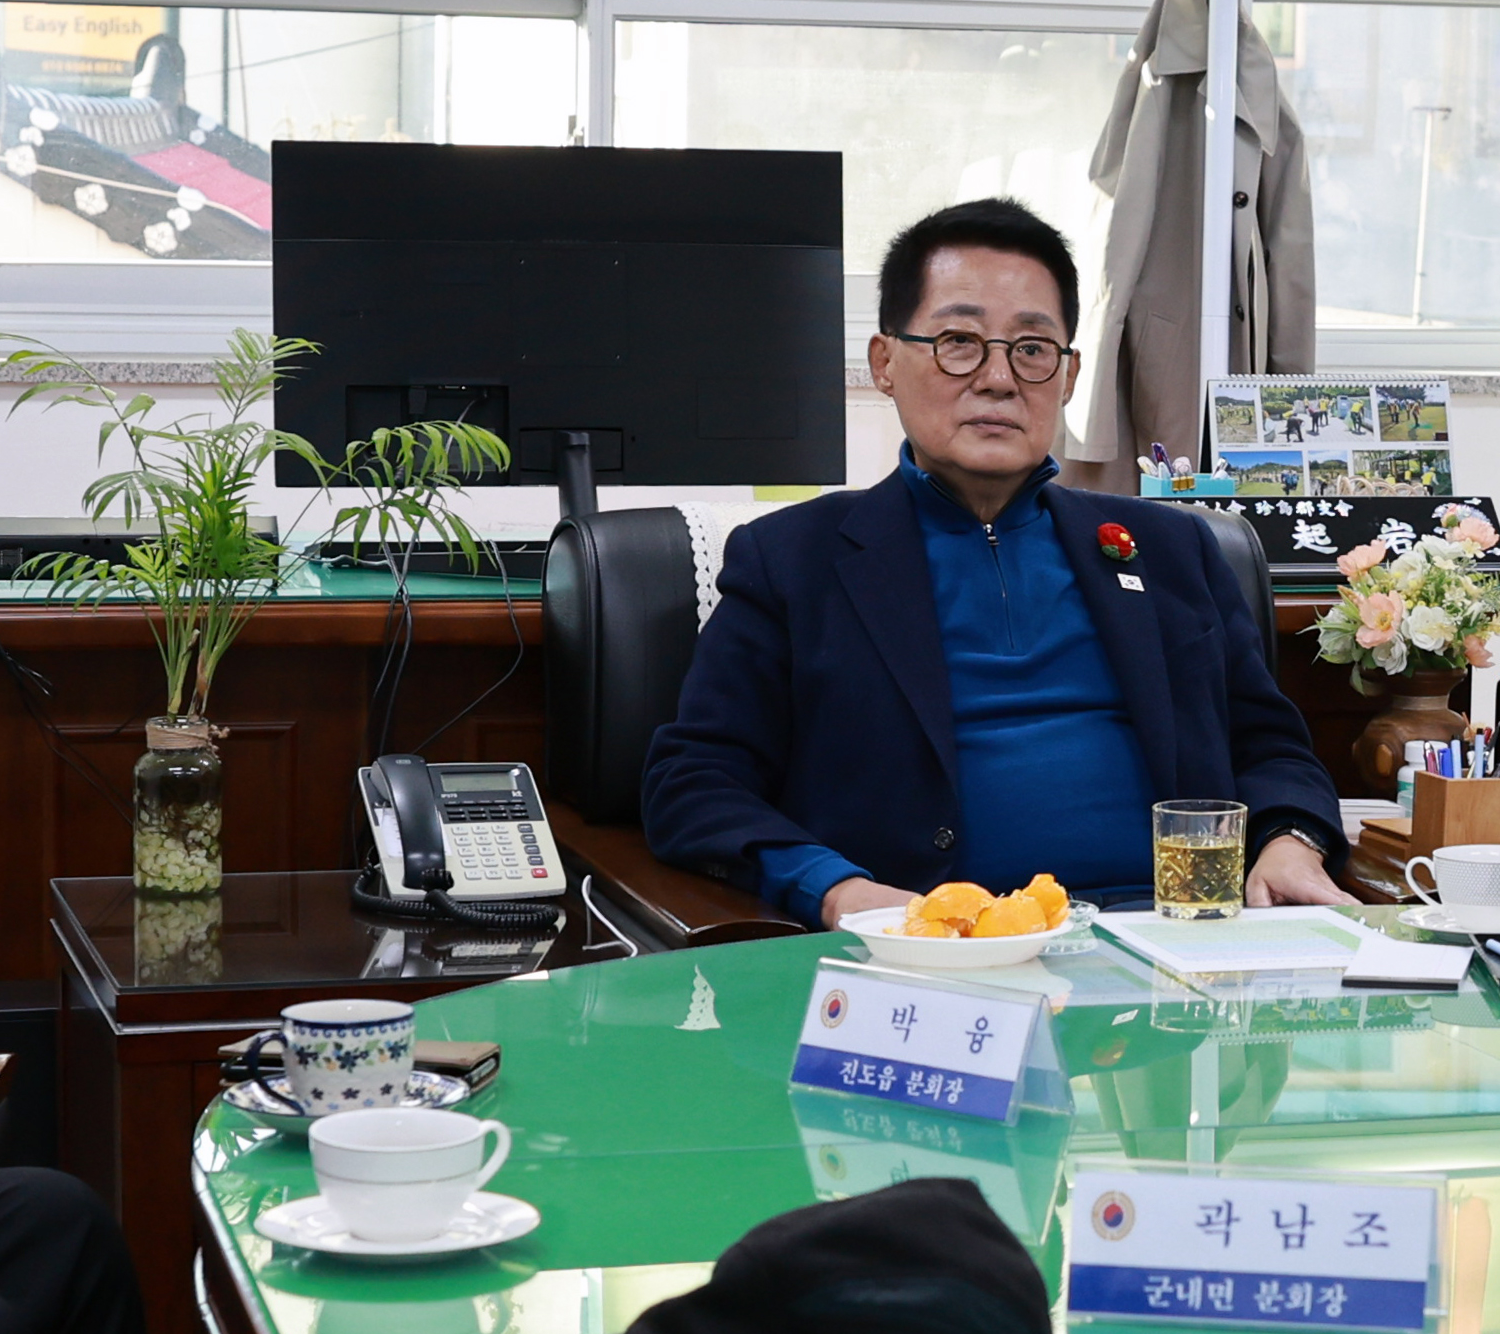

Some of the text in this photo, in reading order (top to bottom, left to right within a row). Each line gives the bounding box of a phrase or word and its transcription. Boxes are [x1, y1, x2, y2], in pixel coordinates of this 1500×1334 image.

[22, 14, 143, 39] Easy English
[839, 1059, 964, 1104] 진도읍 분회장
[1143, 1276, 1348, 1318] 군내면 분회장
